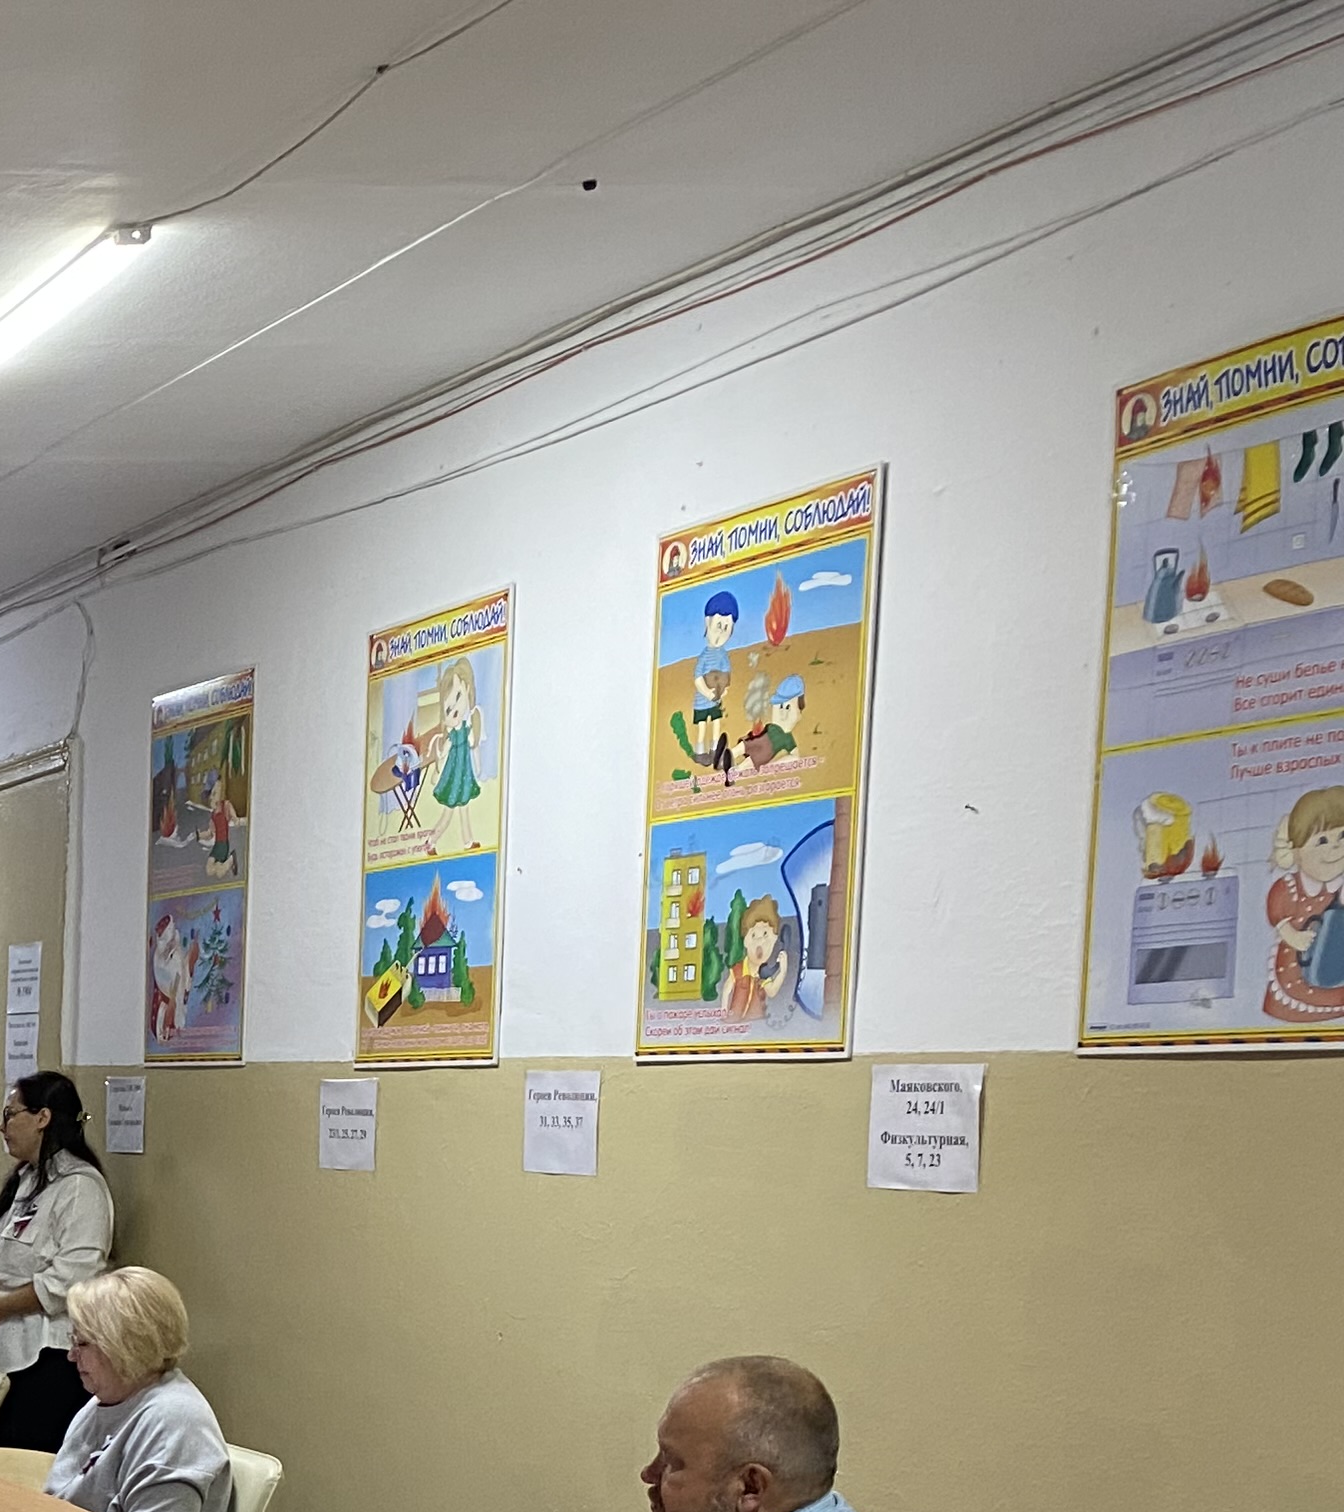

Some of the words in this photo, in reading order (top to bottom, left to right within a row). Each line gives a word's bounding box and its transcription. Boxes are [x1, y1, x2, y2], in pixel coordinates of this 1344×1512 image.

[1162, 373, 1213, 422] ЗНАЙ,
[1214, 350, 1299, 403] ПОМНИ,
[690, 530, 725, 565] ЗНАЙ,
[727, 516, 780, 550] ПОМНИ,
[784, 484, 872, 535] СОБЛЮДАЙ!
[414, 623, 448, 650] ПОМНИ,
[1235, 674, 1253, 688] Не
[1257, 670, 1291, 688] суши
[1295, 660, 1337, 678] белье
[1234, 697, 1256, 711] Все
[1231, 742, 1247, 758] Ты
[1263, 736, 1301, 752] плите
[1305, 732, 1324, 746] не
[1230, 763, 1272, 781] Лучше
[1275, 754, 1342, 774] взрослых
[906, 1100, 921, 1115] 24,
[924, 1100, 944, 1114] 24/1
[880, 1130, 969, 1149] Физкультурная,
[905, 1152, 914, 1169] 5,
[917, 1153, 926, 1169] 7,
[929, 1153, 941, 1167] 23
